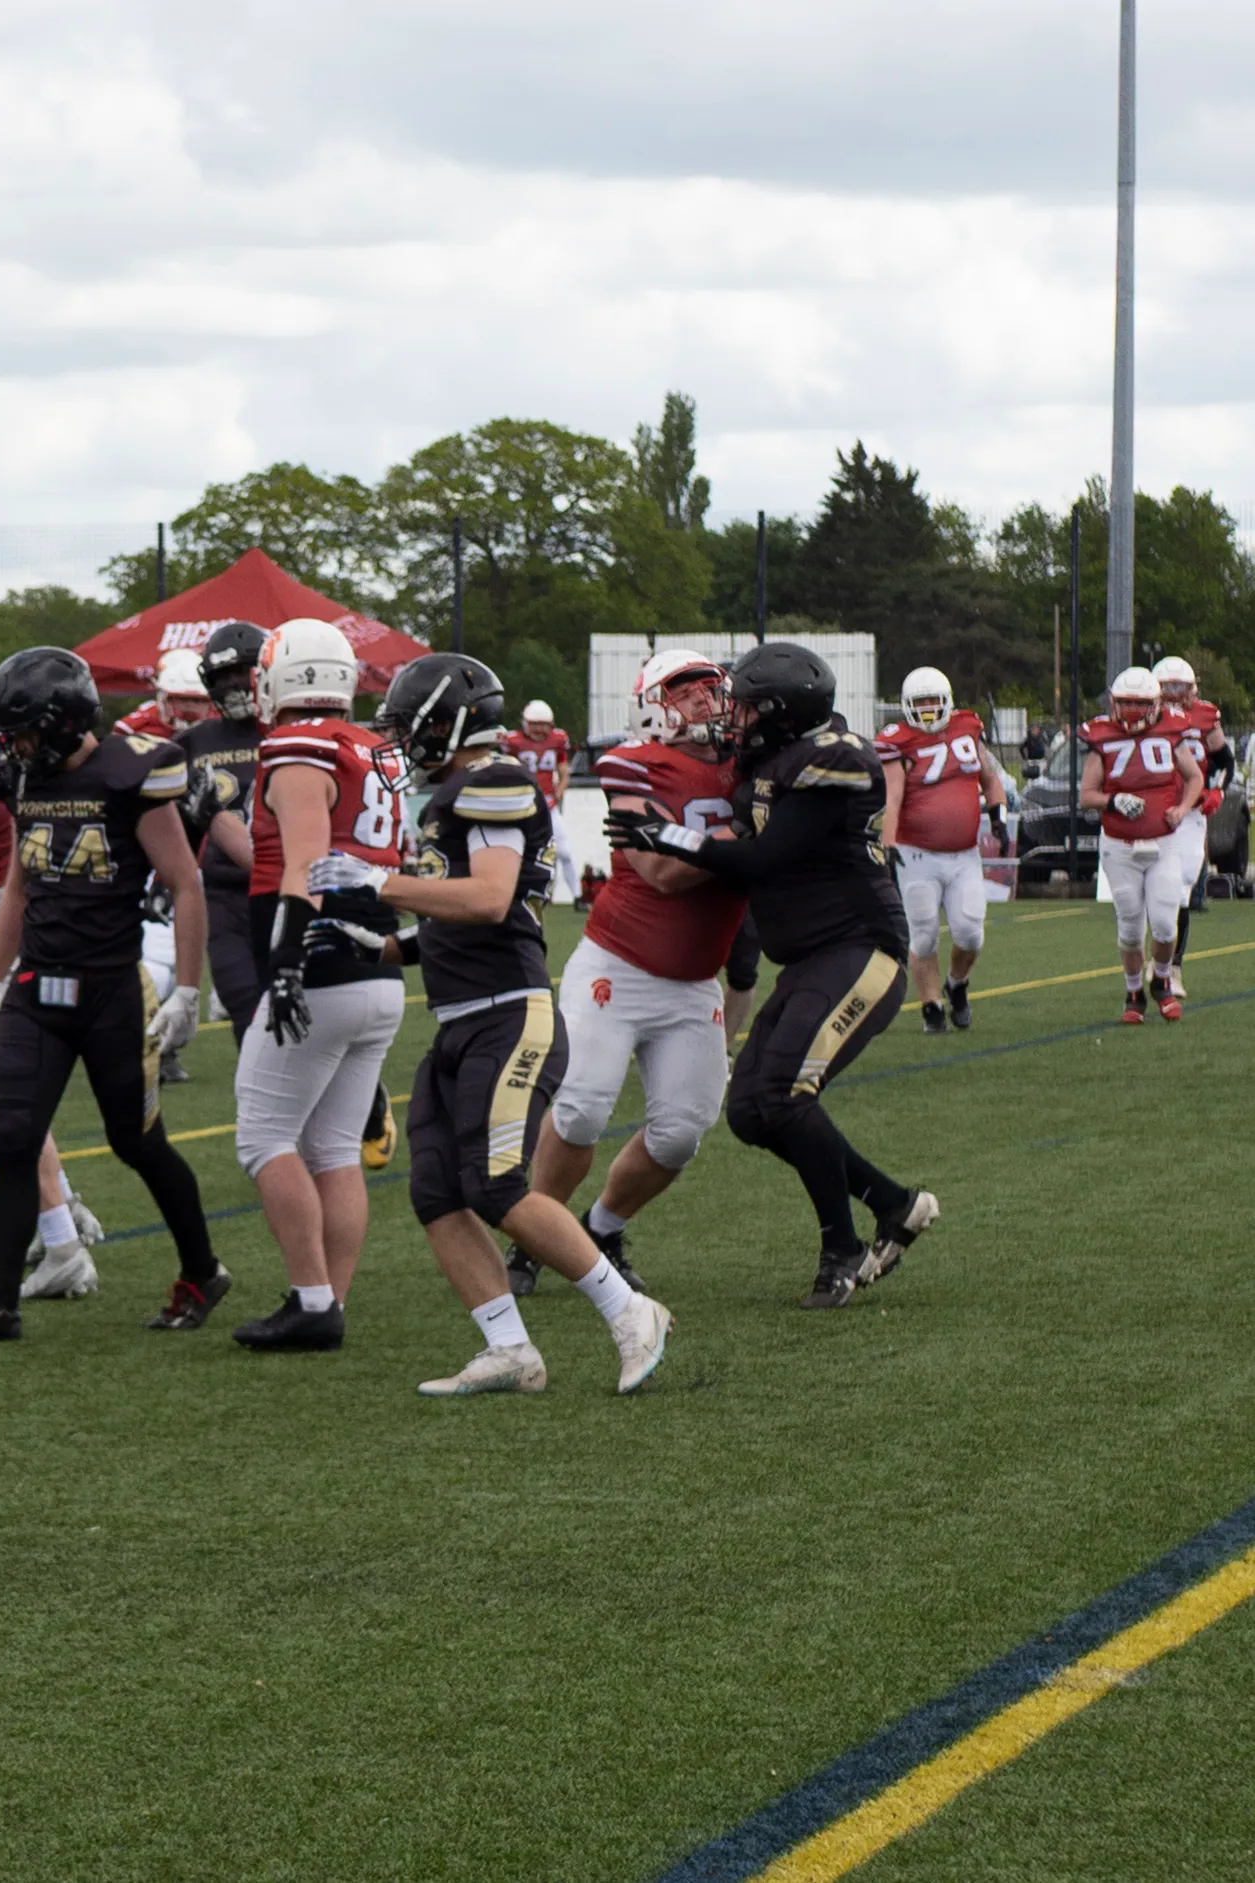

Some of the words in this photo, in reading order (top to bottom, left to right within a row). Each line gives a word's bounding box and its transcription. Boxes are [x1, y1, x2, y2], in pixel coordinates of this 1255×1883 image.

[916, 734, 982, 785] 79
[1103, 736, 1175, 779] 70
[16, 801, 108, 818] YORKSHIRE
[19, 822, 119, 883] 44
[831, 997, 866, 1037] RAMS
[506, 1049, 540, 1090] RAMS
